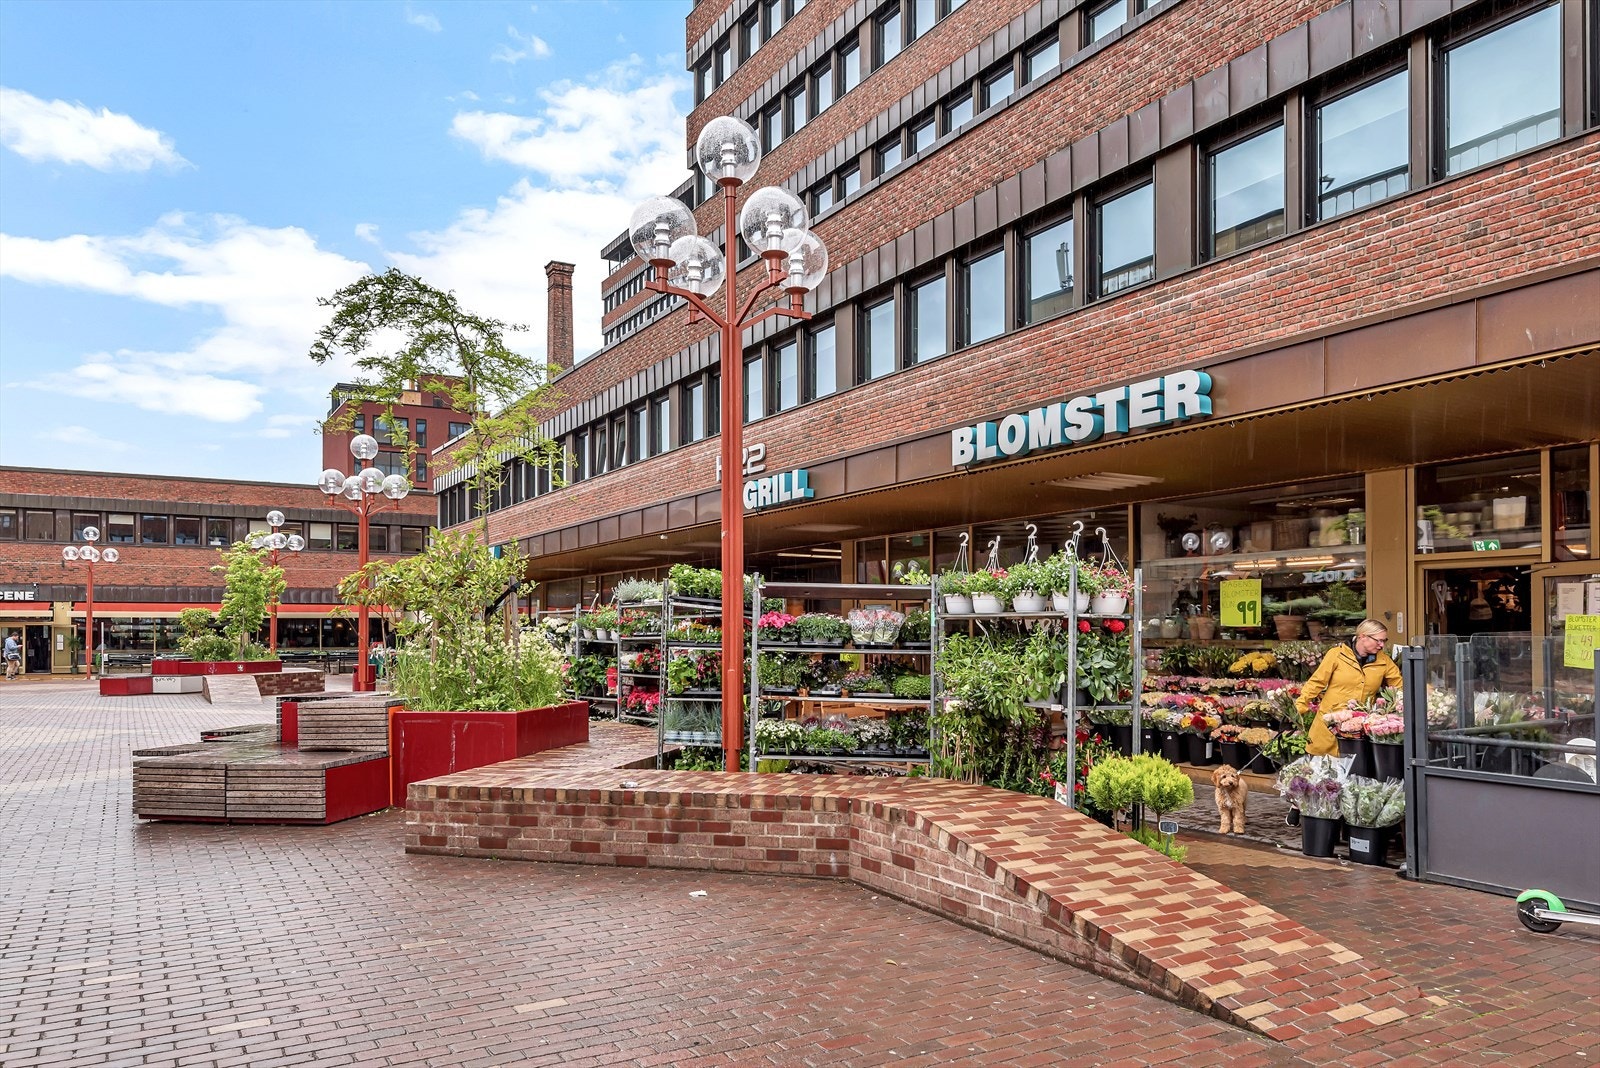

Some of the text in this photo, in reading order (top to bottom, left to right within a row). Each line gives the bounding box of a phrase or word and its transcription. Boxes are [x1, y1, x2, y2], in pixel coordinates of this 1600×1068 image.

[952, 370, 1211, 467] BLOMSTER
[743, 469, 814, 509] GRILL
[1237, 601, 1257, 624] 99
[1568, 615, 1598, 623] BLOMSTER
